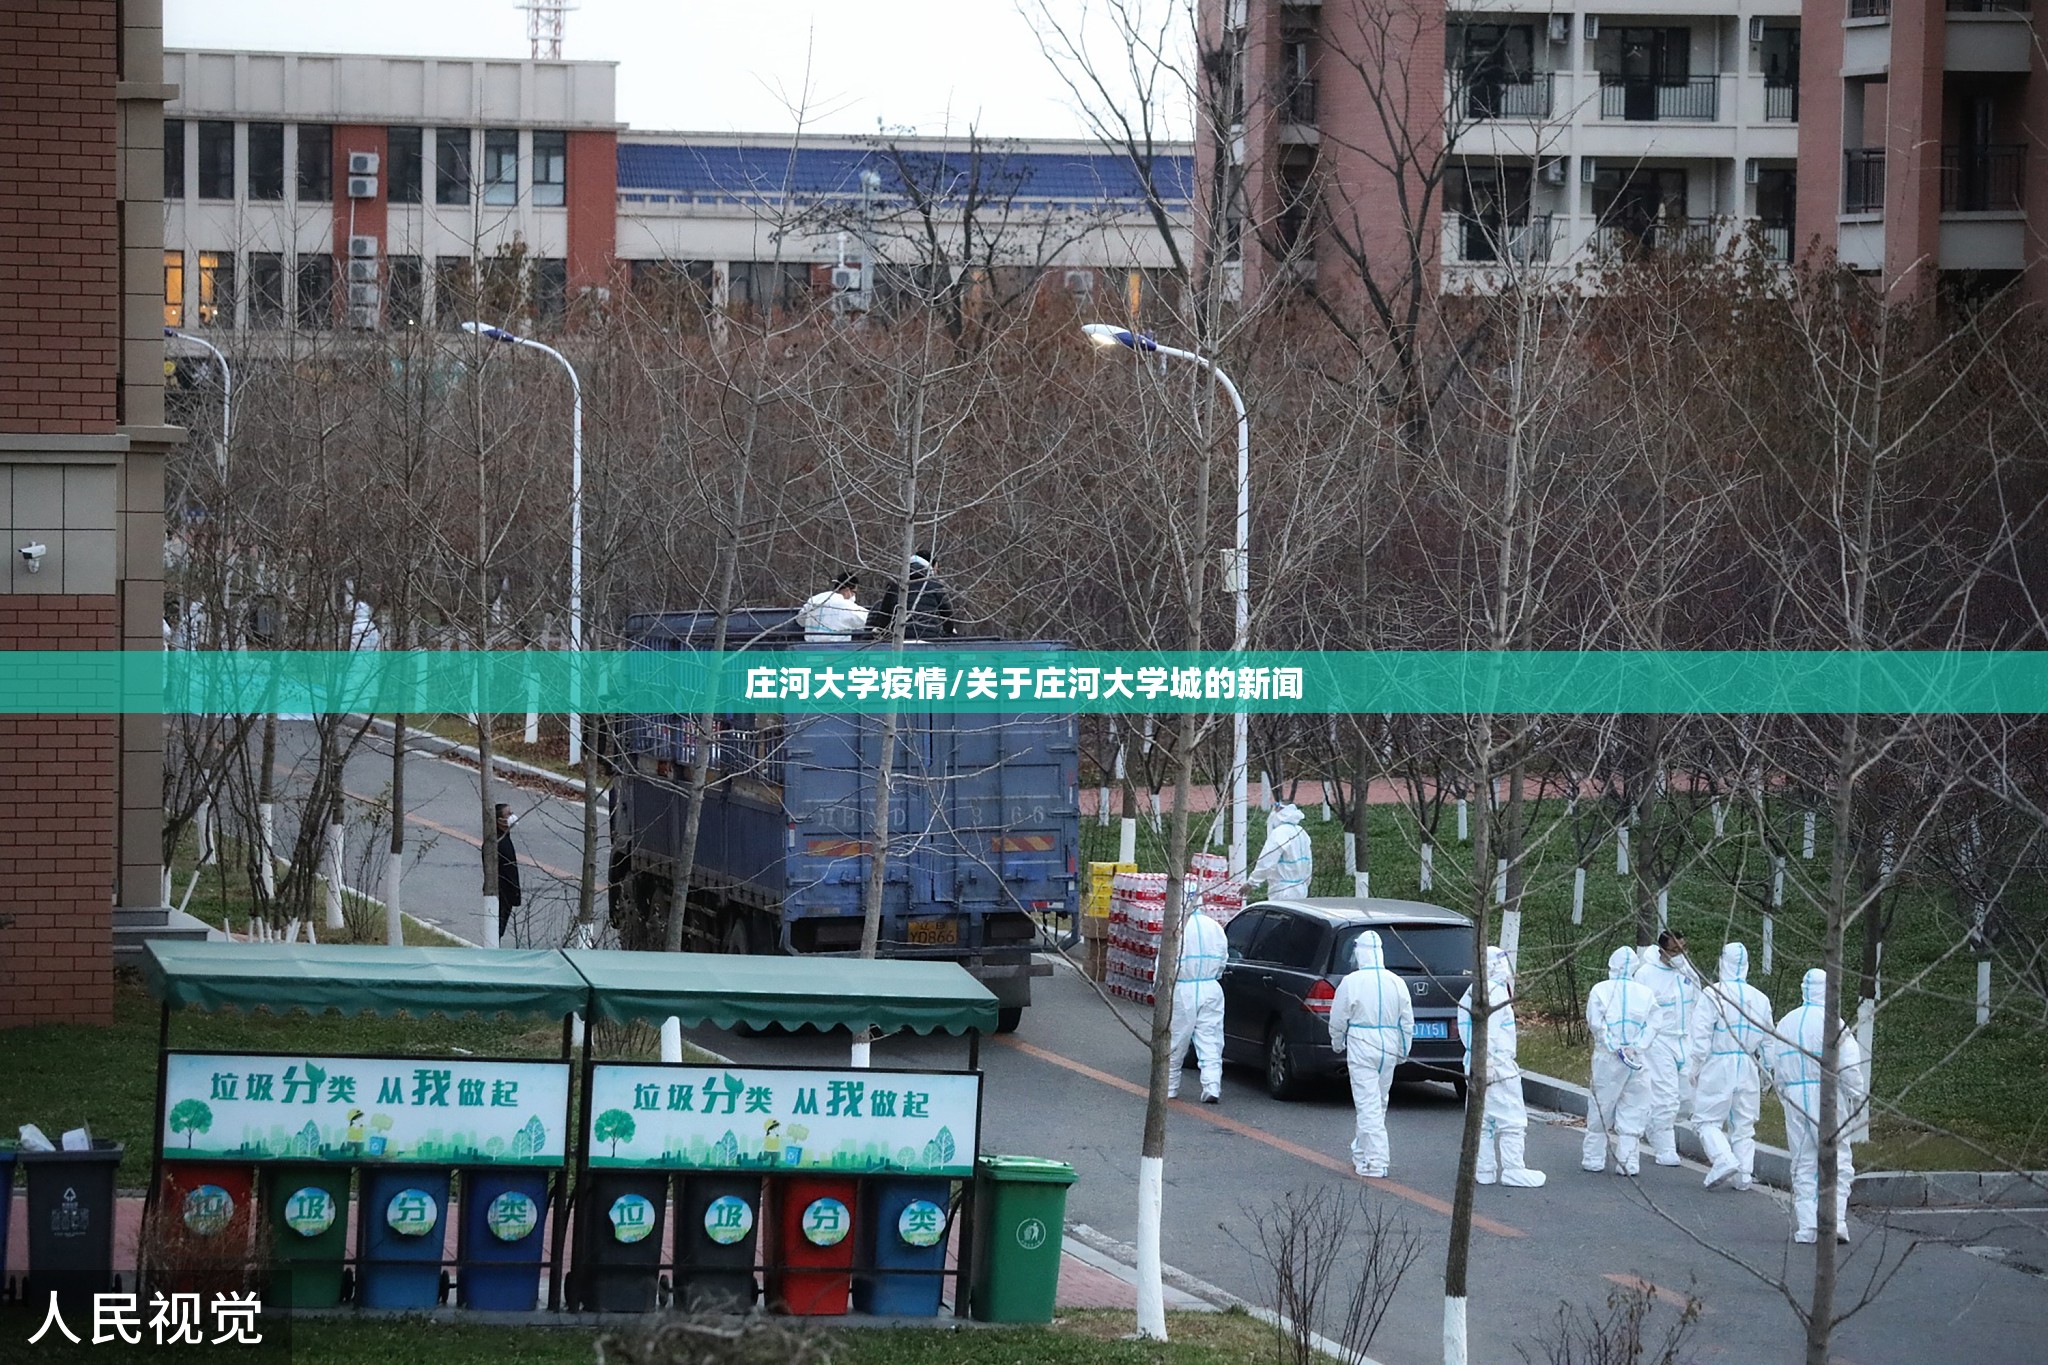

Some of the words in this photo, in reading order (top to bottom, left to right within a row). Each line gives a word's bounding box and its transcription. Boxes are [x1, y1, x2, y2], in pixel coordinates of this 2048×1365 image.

[910, 931, 955, 943] YD866
[209, 1060, 357, 1104] 垃圾分类
[376, 1068, 519, 1108] 从我做起
[632, 1070, 773, 1114] 垃圾分类
[792, 1080, 930, 1119] 从我做起
[298, 1195, 325, 1221] 圾
[397, 1197, 426, 1222] 分
[499, 1199, 527, 1224] 类
[617, 1201, 645, 1227] 垃
[716, 1203, 742, 1228] 圾
[813, 1206, 840, 1230] 分
[909, 1208, 937, 1232] 类
